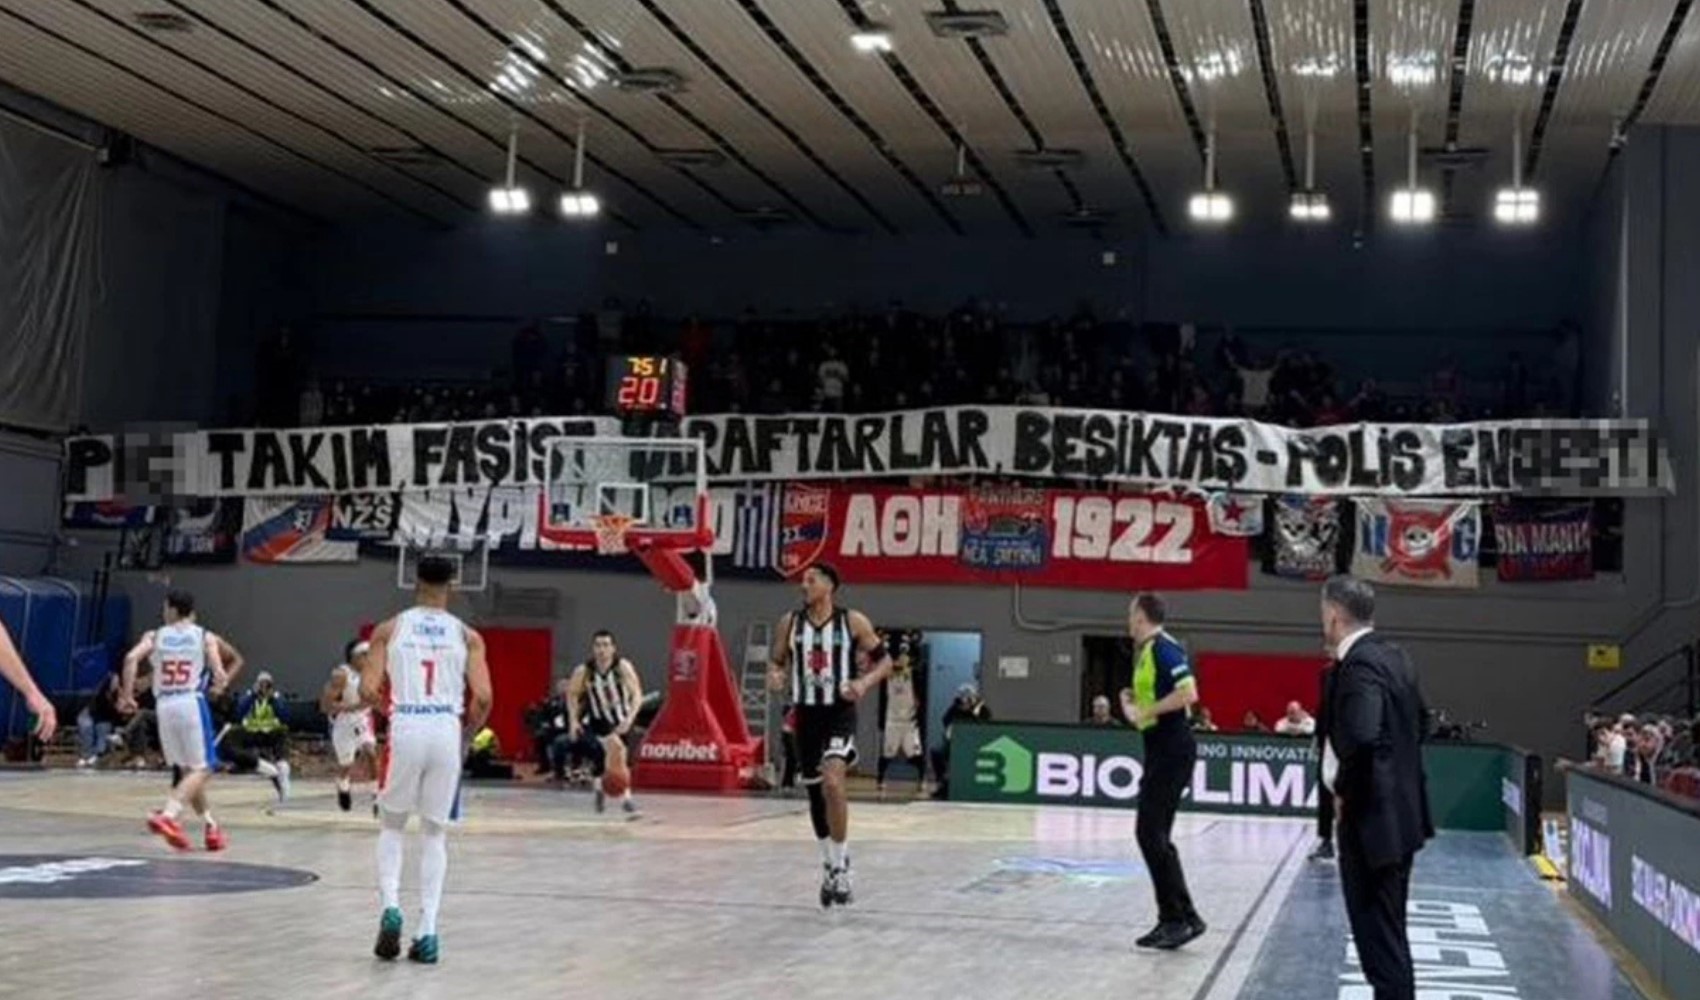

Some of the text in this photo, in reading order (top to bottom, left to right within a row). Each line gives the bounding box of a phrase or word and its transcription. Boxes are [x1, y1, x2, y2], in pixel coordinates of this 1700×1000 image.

[618, 377, 659, 403] 20
[1052, 496, 1194, 563] 1922
[161, 660, 192, 687] 55
[640, 738, 718, 759] novibet
[1036, 752, 1319, 808] BIOLIM
